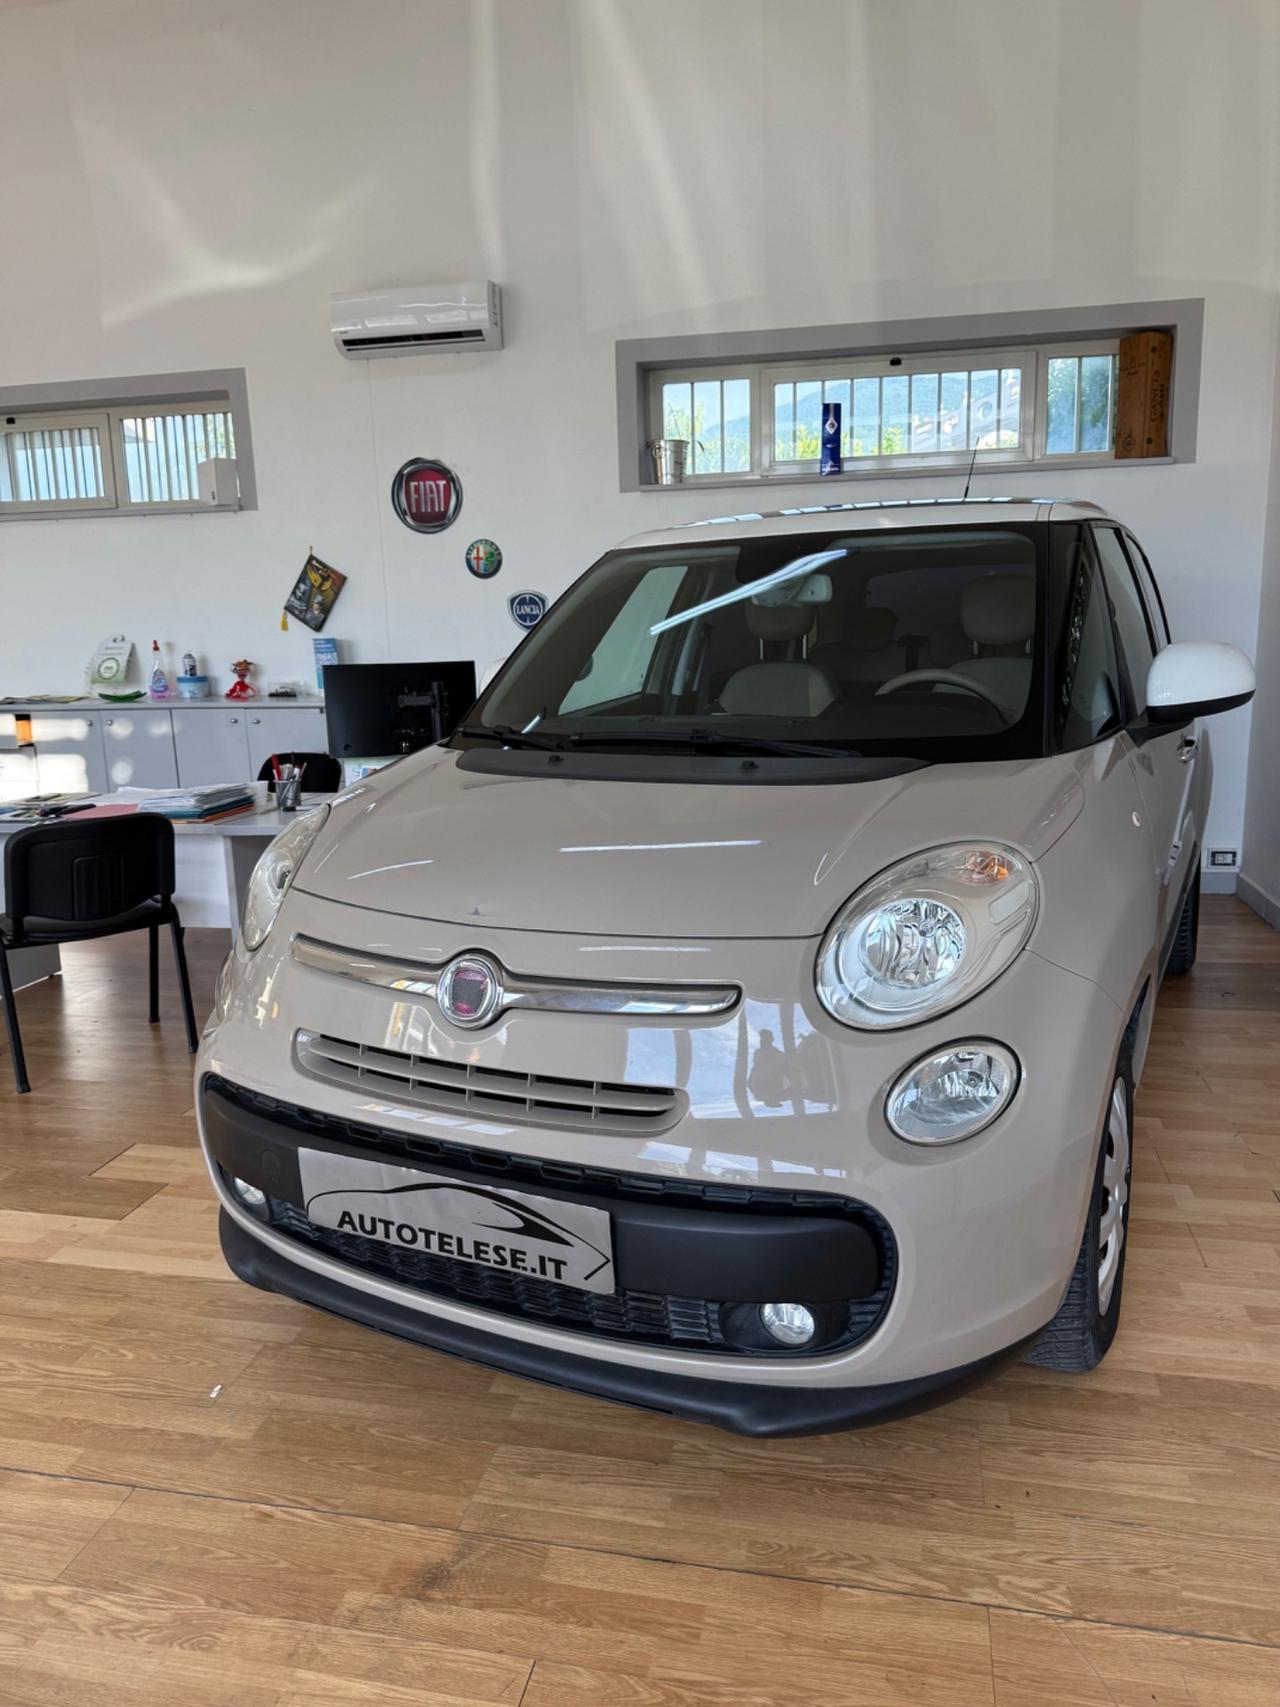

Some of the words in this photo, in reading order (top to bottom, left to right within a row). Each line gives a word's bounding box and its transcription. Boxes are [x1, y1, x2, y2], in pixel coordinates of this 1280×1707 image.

[409, 480, 447, 513] FIAT
[516, 604, 540, 615] LANCIA
[337, 1210, 568, 1281] AUTOTELESE.IT
